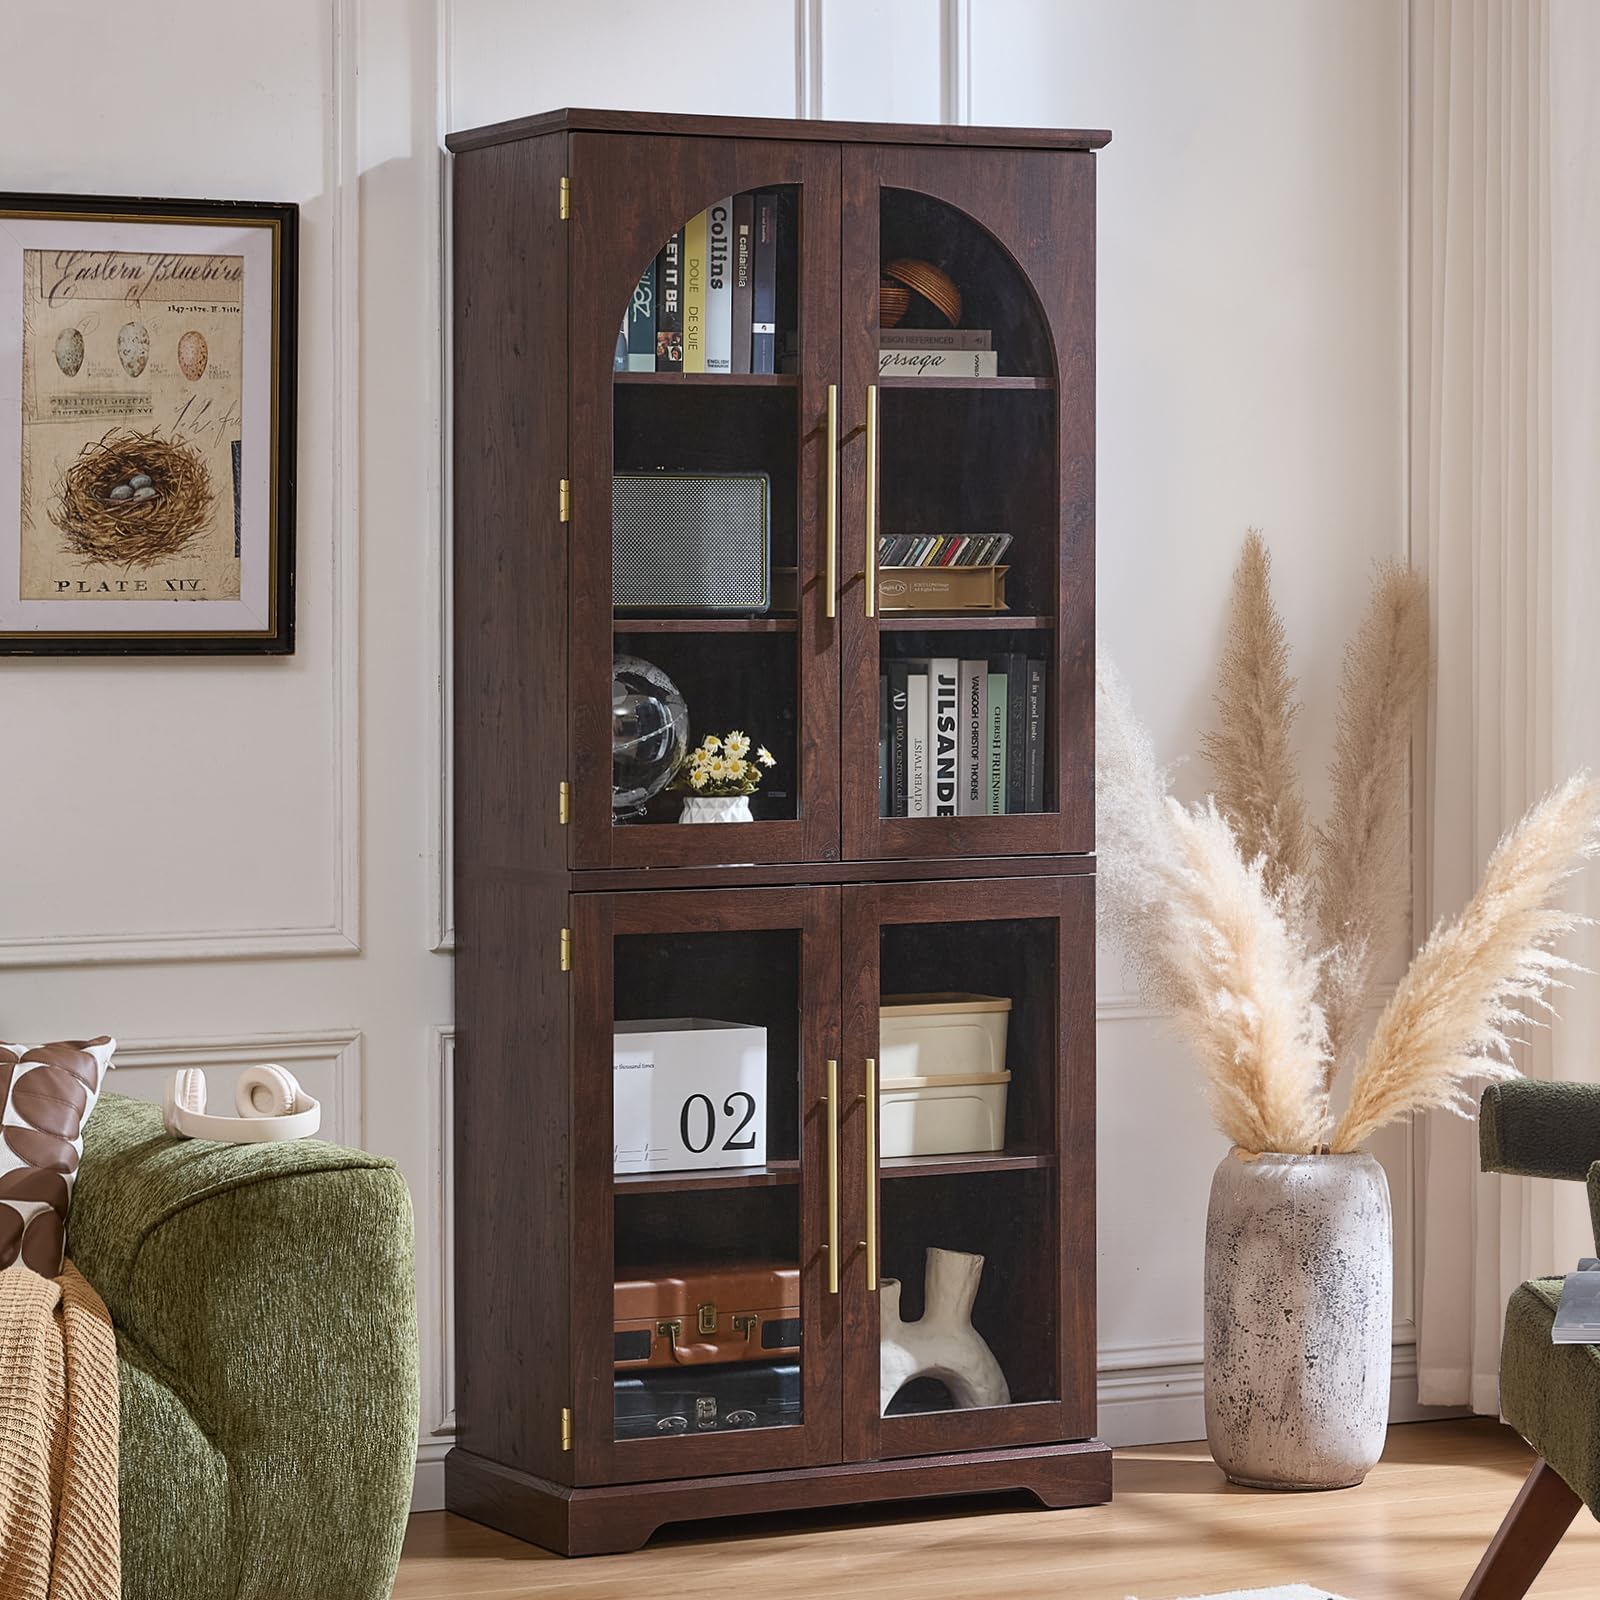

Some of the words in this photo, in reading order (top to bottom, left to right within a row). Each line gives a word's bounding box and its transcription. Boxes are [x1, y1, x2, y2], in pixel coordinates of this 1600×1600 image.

[666, 233, 678, 265] ET
[710, 206, 728, 290] Collins
[666, 269, 678, 285] IT
[666, 290, 678, 313] BE
[687, 306, 699, 322] DE
[54, 580, 148, 593] PLATE
[893, 688, 907, 711] AD
[971, 675, 980, 719] VANGOGH
[1031, 685, 1039, 694] in
[1030, 696, 1039, 718] good
[896, 725, 904, 741] 100
[970, 720, 980, 761] CHRISTOF
[993, 706, 1001, 749] CHERISH
[896, 749, 904, 787] CENTURY
[914, 738, 923, 771] TWIST
[914, 773, 923, 812] OLIVER
[970, 763, 979, 801] THOENES
[680, 1091, 756, 1154] 02
